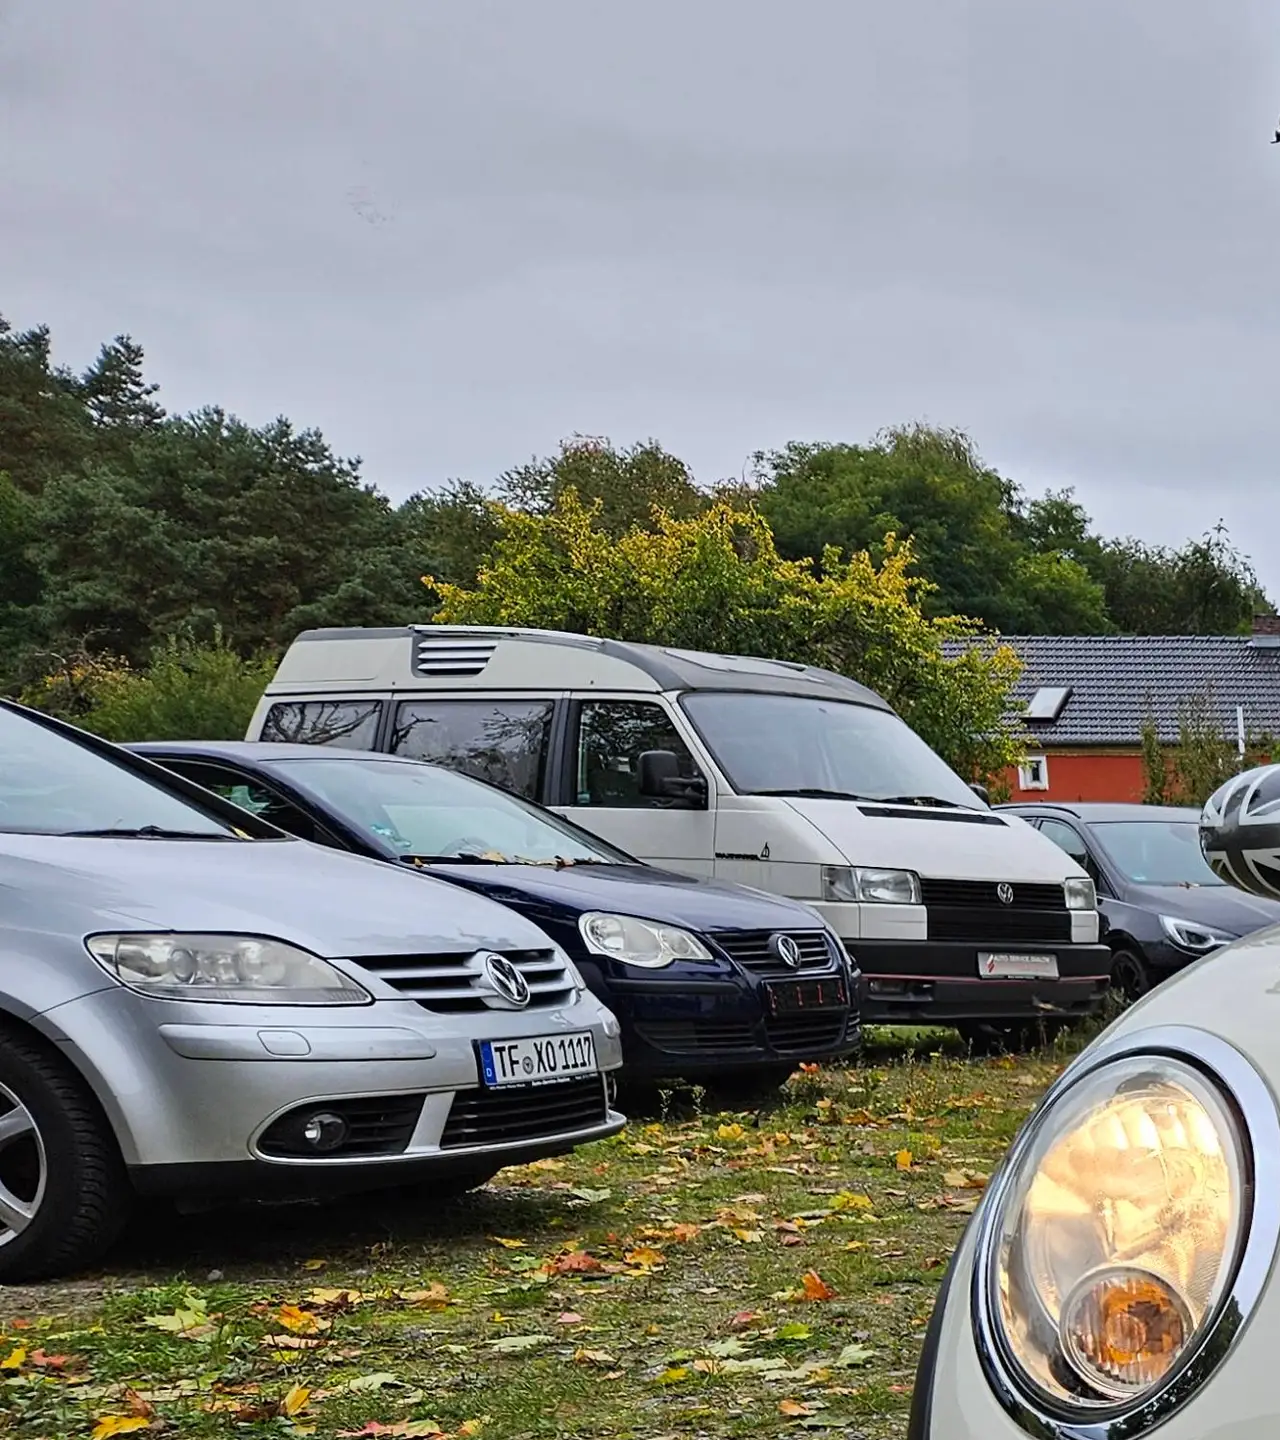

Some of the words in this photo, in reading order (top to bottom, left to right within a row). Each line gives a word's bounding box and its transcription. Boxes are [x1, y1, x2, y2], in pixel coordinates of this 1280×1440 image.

[494, 1045, 519, 1078] TF
[534, 1040, 557, 1074] XO
[559, 1036, 592, 1070] 1117
[486, 1068, 492, 1077] D
